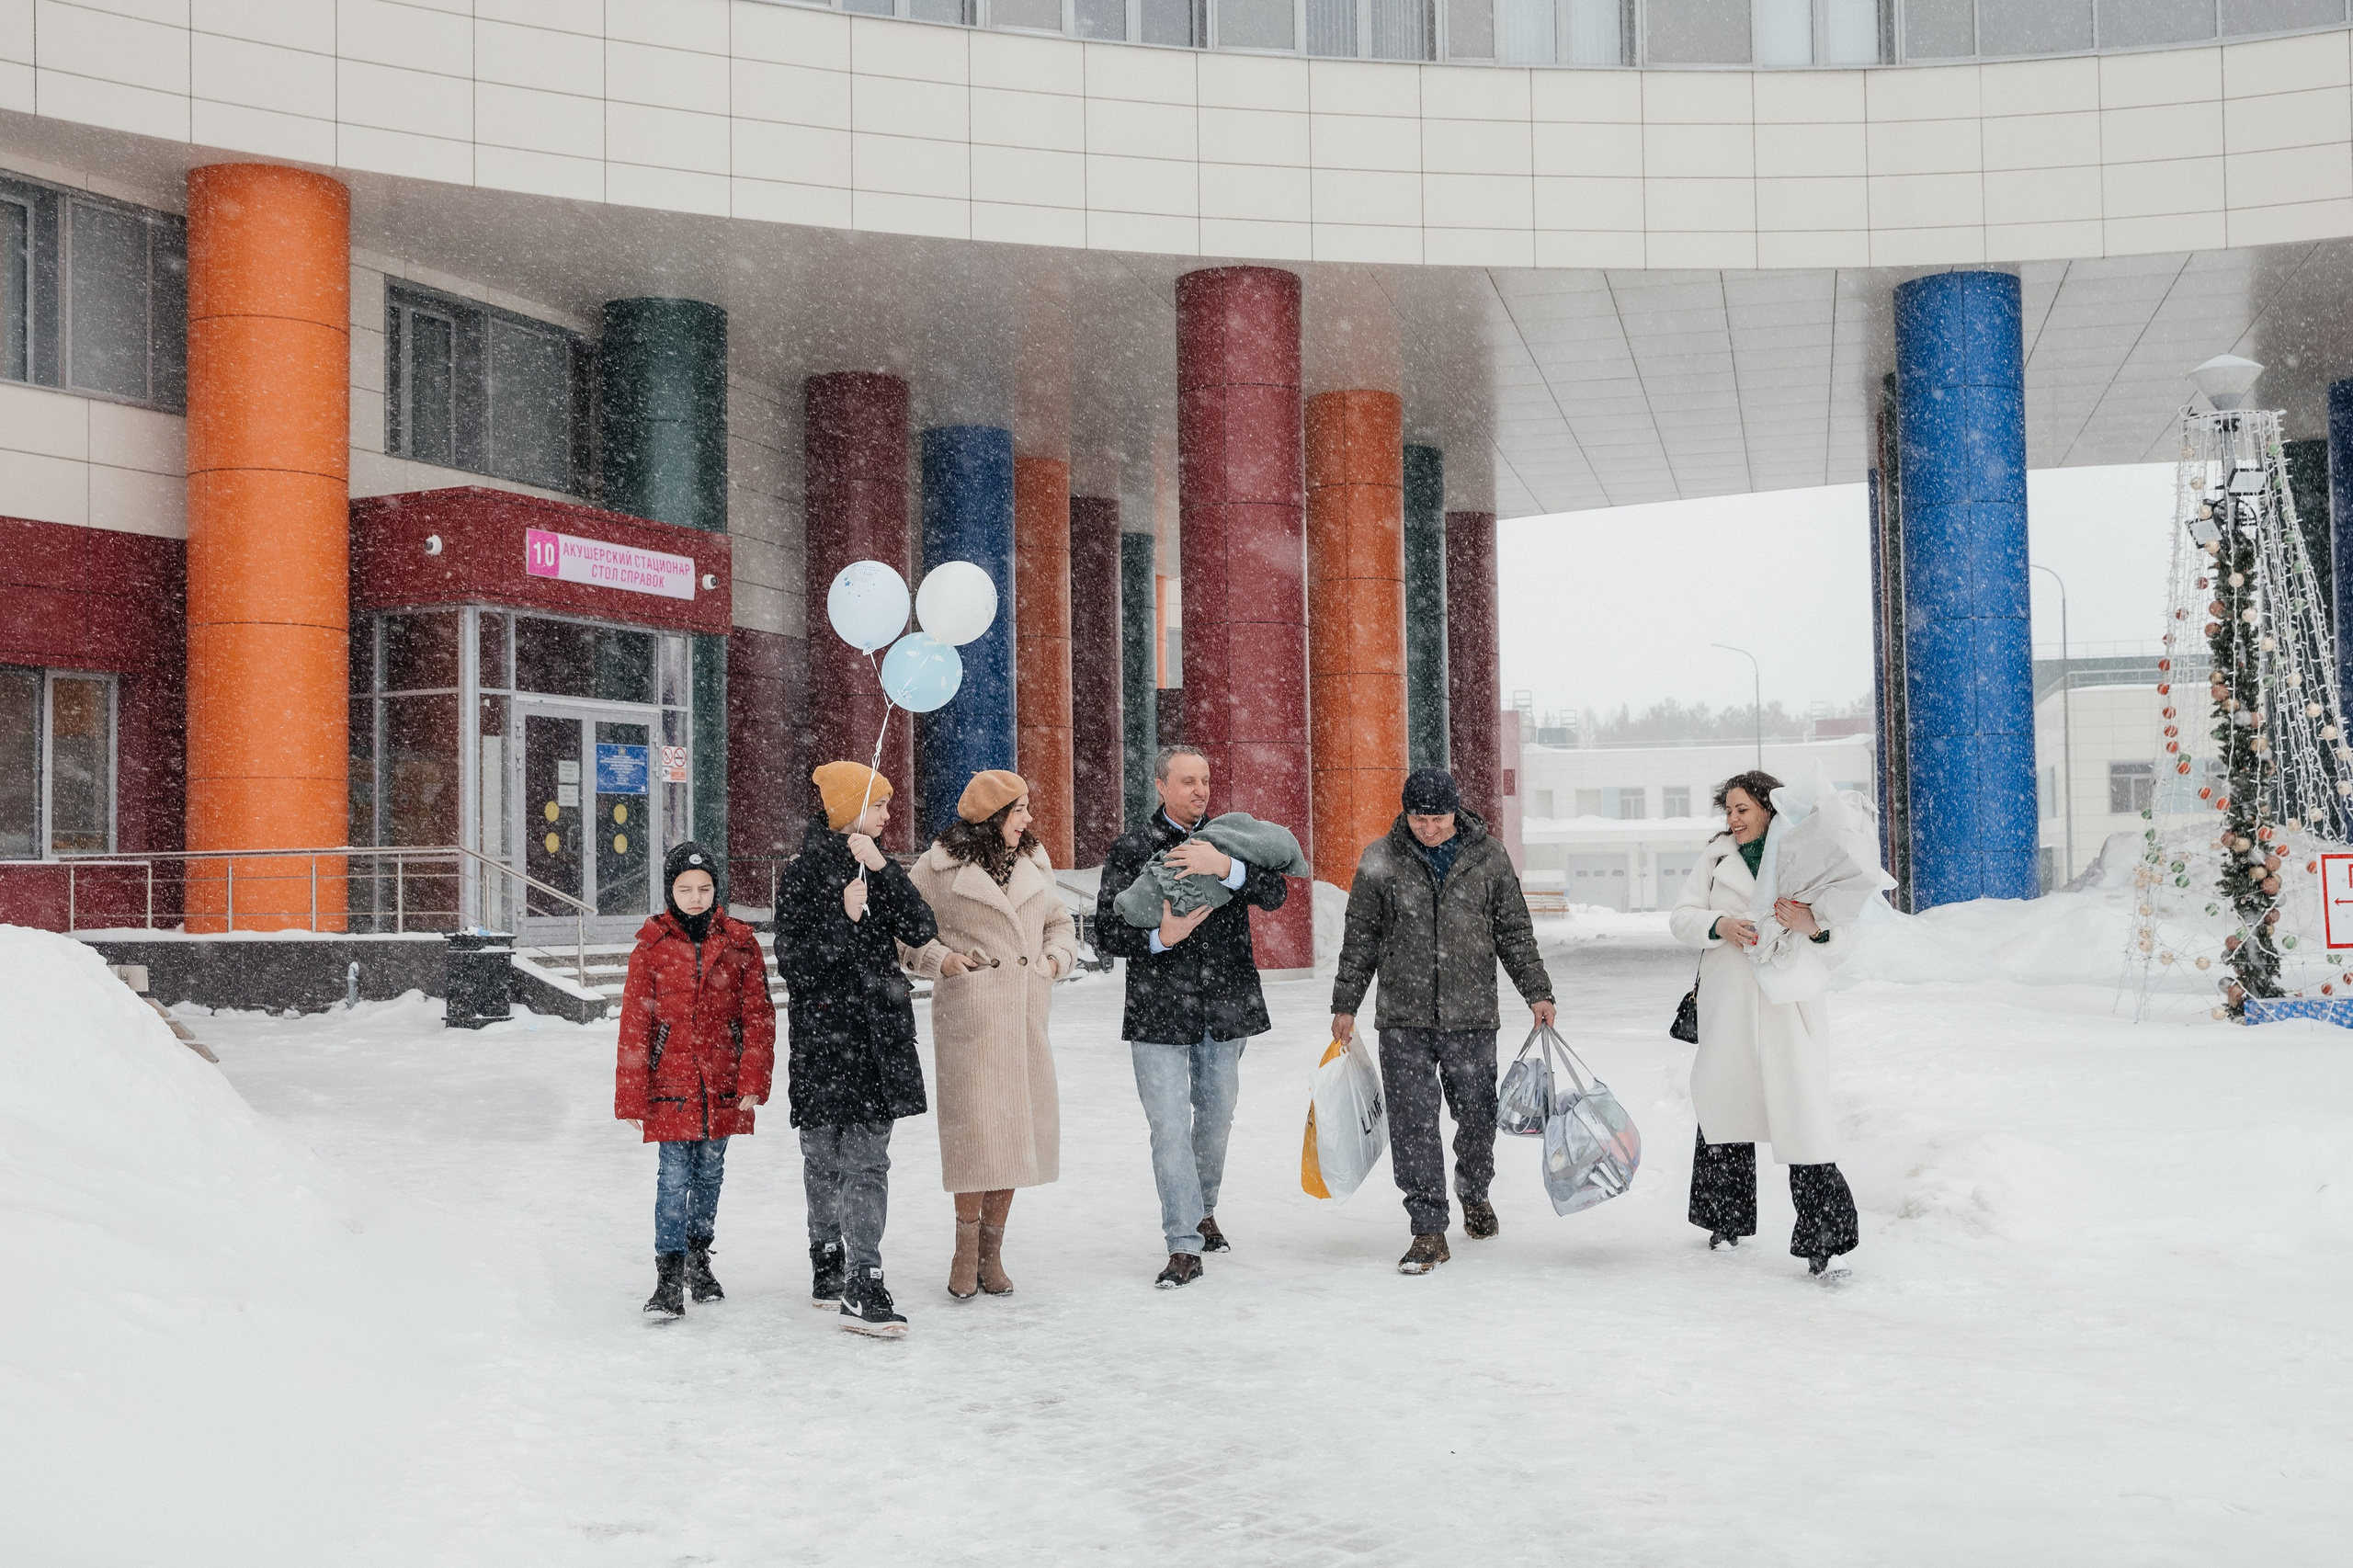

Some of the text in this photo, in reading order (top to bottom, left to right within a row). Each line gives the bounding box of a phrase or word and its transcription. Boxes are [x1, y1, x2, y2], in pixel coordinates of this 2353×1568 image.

[533, 541, 555, 567] 10
[563, 542, 690, 576] АКУШЕРСКИЙ СТАЦИОНАР
[591, 565, 665, 589] СТОЛ СПРАВОК
